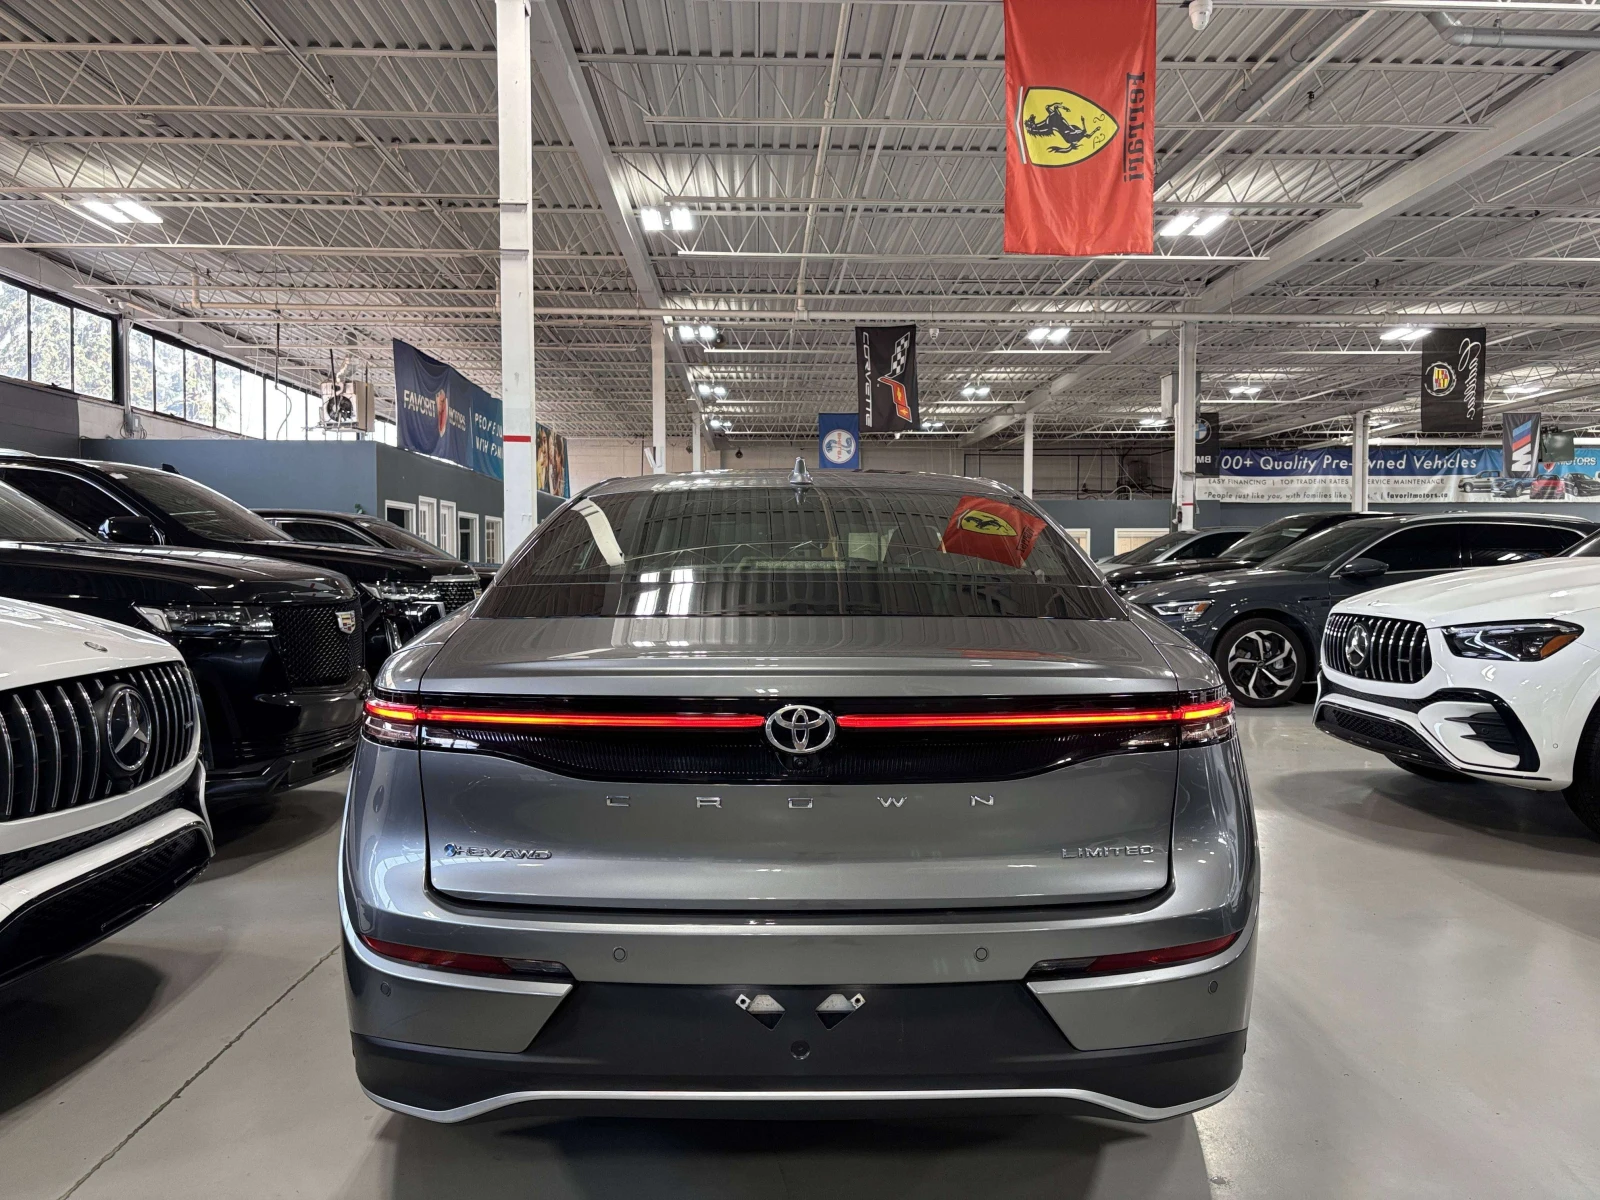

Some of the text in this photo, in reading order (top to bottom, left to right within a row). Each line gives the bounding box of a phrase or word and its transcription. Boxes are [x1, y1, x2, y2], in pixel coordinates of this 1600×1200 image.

[862, 331, 873, 428] CORVETTE
[403, 389, 436, 418] FAVORIT
[1260, 454, 1317, 473] Quality
[1322, 453, 1406, 470] Pre-wned
[1413, 453, 1477, 470] Vehicles
[1227, 478, 1267, 486] FINANCING
[1235, 491, 1249, 500] just
[1251, 491, 1265, 499] like
[1285, 491, 1301, 499] with
[1303, 491, 1332, 499] families
[1334, 491, 1347, 499] like
[1386, 491, 1448, 499] favoritmotors.ca
[606, 794, 994, 809] CROWN
[1061, 844, 1155, 859] LIMITED
